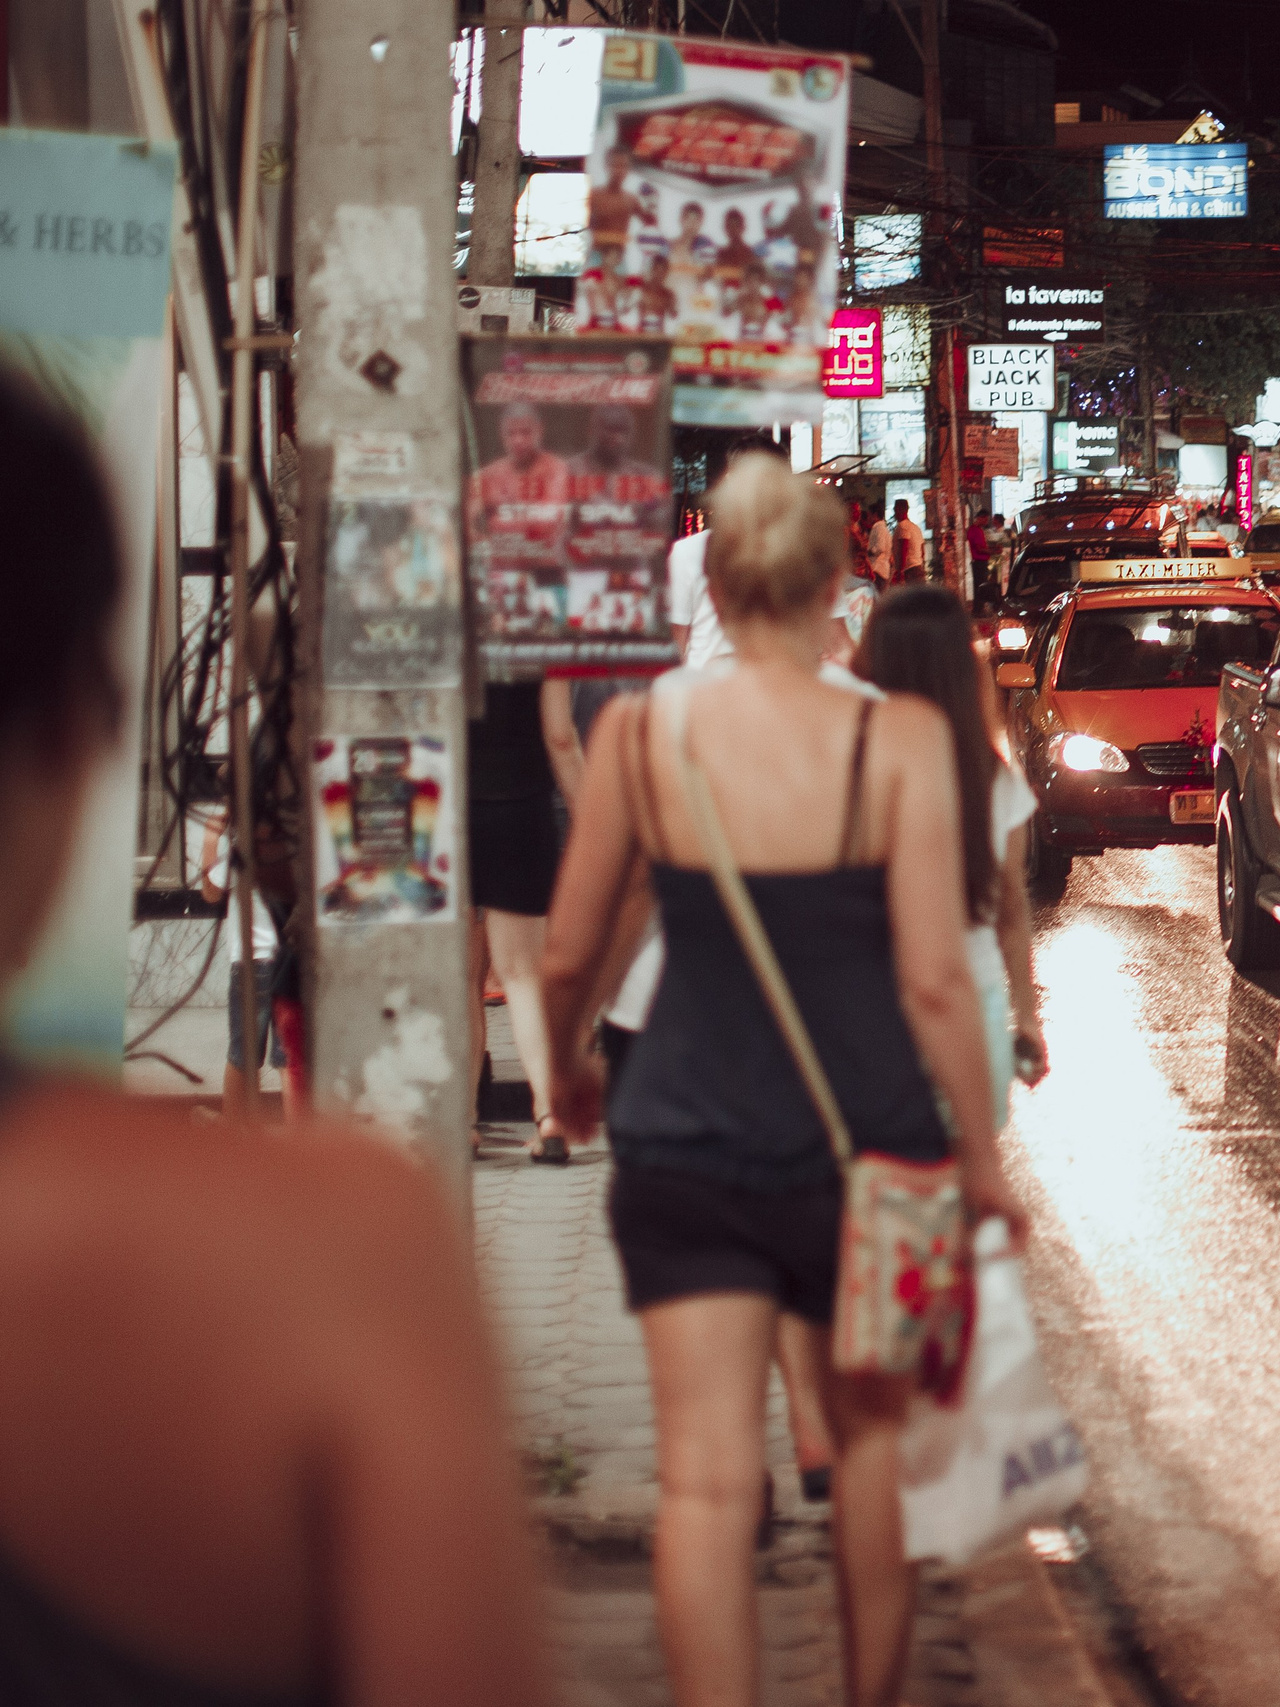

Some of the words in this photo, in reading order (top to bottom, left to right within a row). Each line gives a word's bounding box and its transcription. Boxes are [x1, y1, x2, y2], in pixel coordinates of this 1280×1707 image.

[33, 215, 167, 258] HERBS
[1028, 285, 1104, 304] taverna
[973, 349, 1049, 365] BLACK
[981, 370, 1041, 386] JACK
[989, 391, 1034, 407] PUB
[1072, 546, 1111, 555] TAXI
